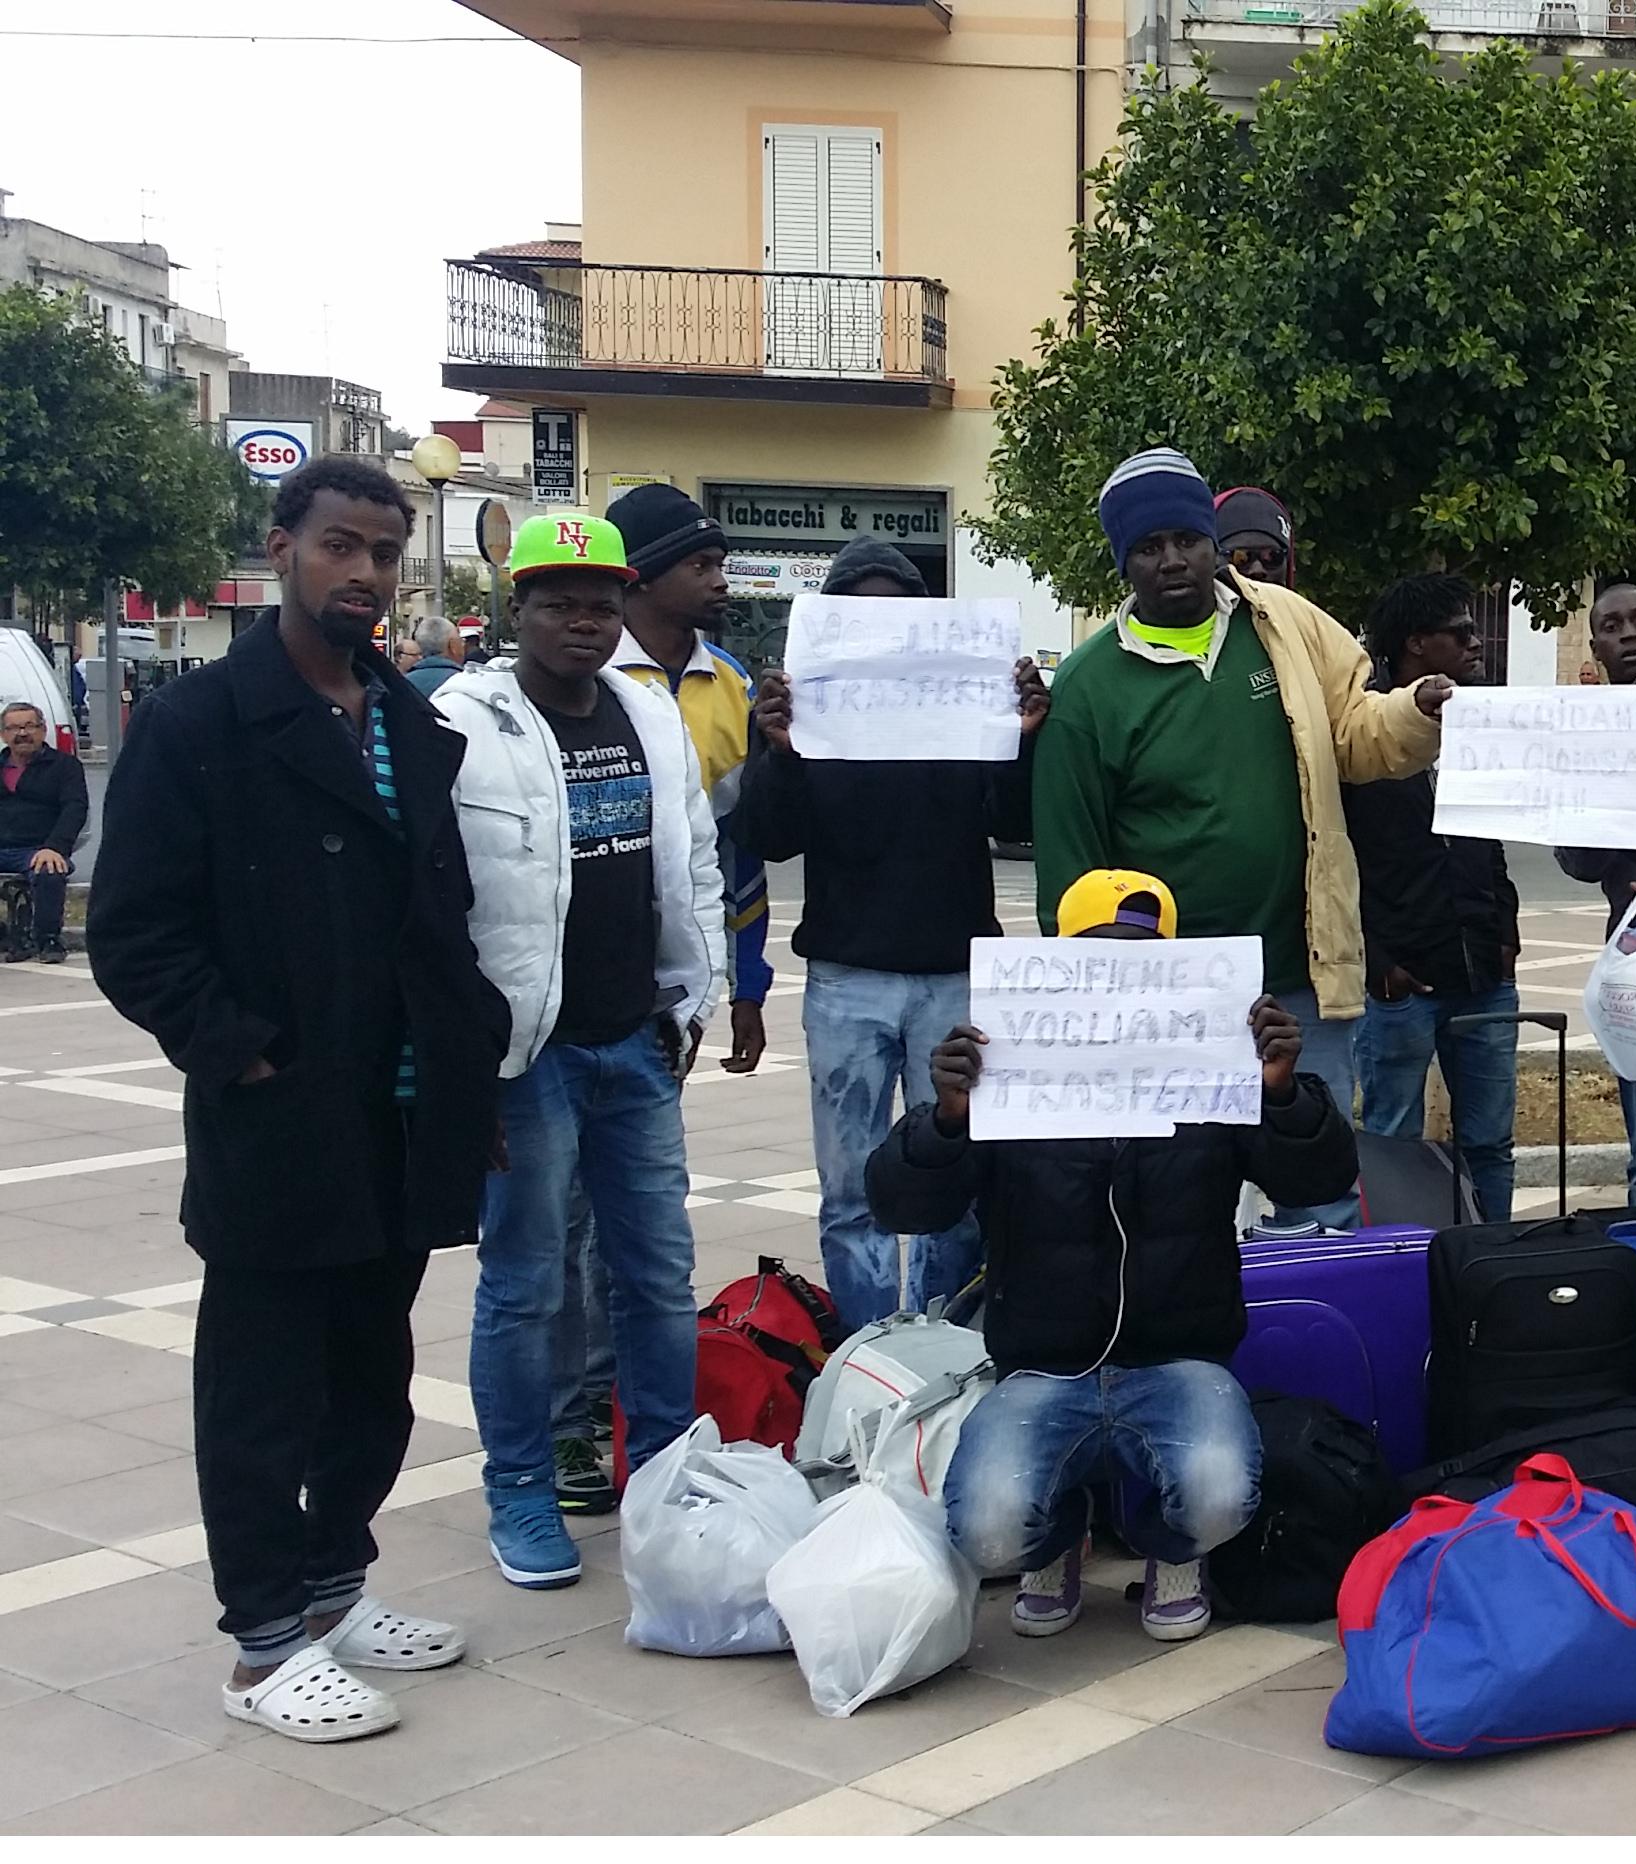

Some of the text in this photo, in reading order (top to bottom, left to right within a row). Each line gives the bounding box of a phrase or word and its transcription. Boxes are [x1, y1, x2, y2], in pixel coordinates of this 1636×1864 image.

[535, 459, 573, 467] TABACCHI
[538, 489, 570, 497] LOTTO
[727, 502, 940, 537] tabacchi & regali
[556, 522, 592, 557] NY
[573, 745, 629, 768] prima
[631, 761, 642, 773] a
[988, 956, 1191, 996] MODIFICHE
